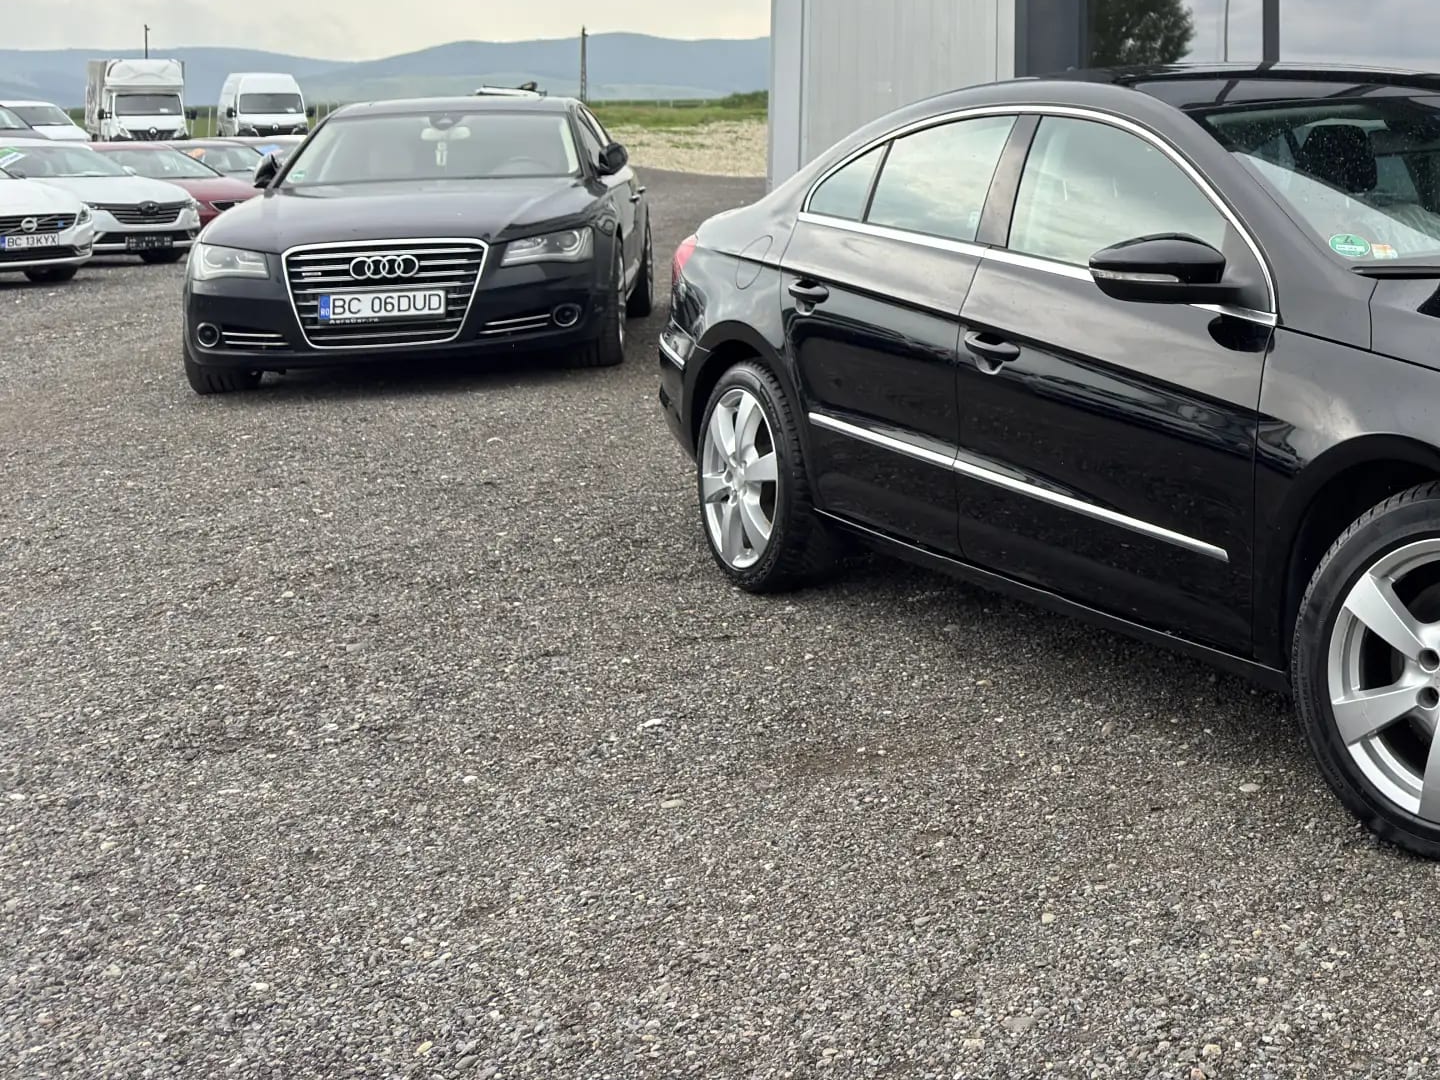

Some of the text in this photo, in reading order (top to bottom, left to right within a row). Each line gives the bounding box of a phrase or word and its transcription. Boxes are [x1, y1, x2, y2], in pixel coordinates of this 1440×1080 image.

[7, 237, 21, 247] BC
[332, 293, 442, 316] BC 06DUD
[320, 307, 330, 317] RO
